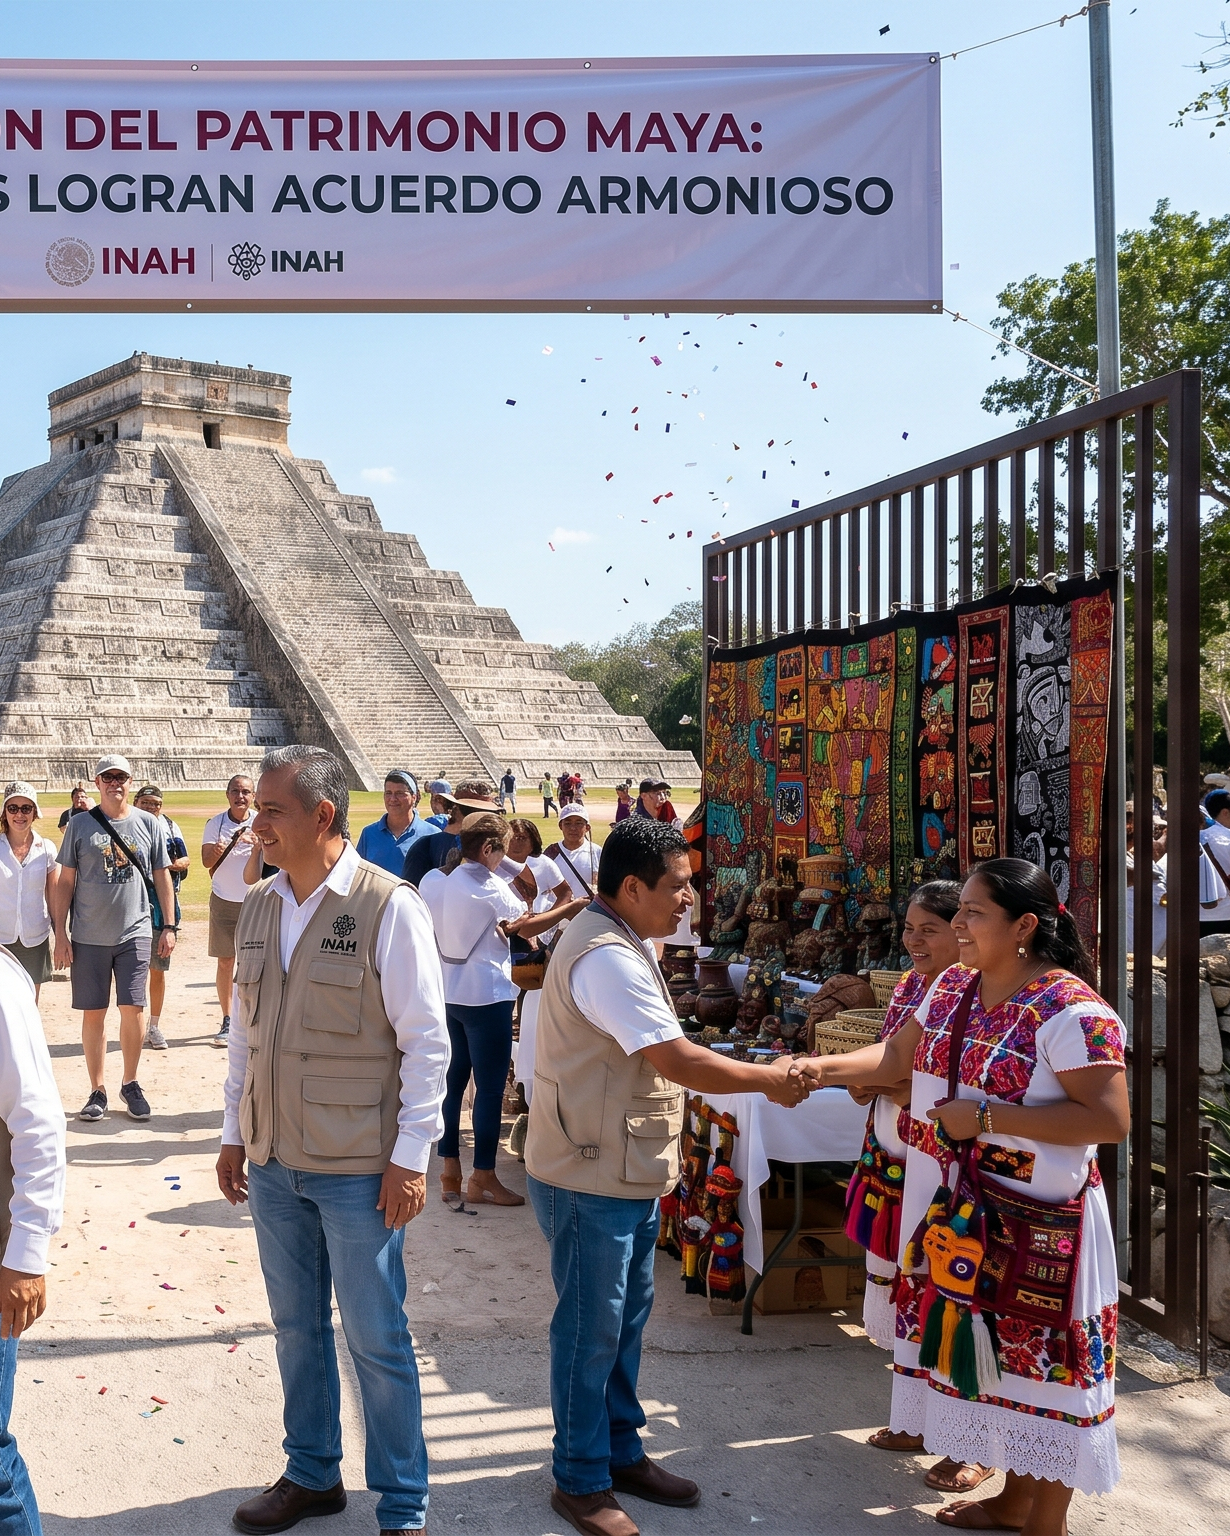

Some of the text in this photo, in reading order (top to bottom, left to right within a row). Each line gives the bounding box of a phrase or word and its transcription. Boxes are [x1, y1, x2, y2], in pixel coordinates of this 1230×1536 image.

[65, 110, 178, 151] DEL
[196, 110, 567, 153] PATRIMONIO
[587, 112, 763, 154] MAYA:
[28, 174, 254, 214] LOGRAN
[271, 175, 542, 215] ACUERDO
[556, 176, 894, 216] ARMONIOSO
[102, 247, 195, 275] INAH
[271, 250, 344, 273] INAH
